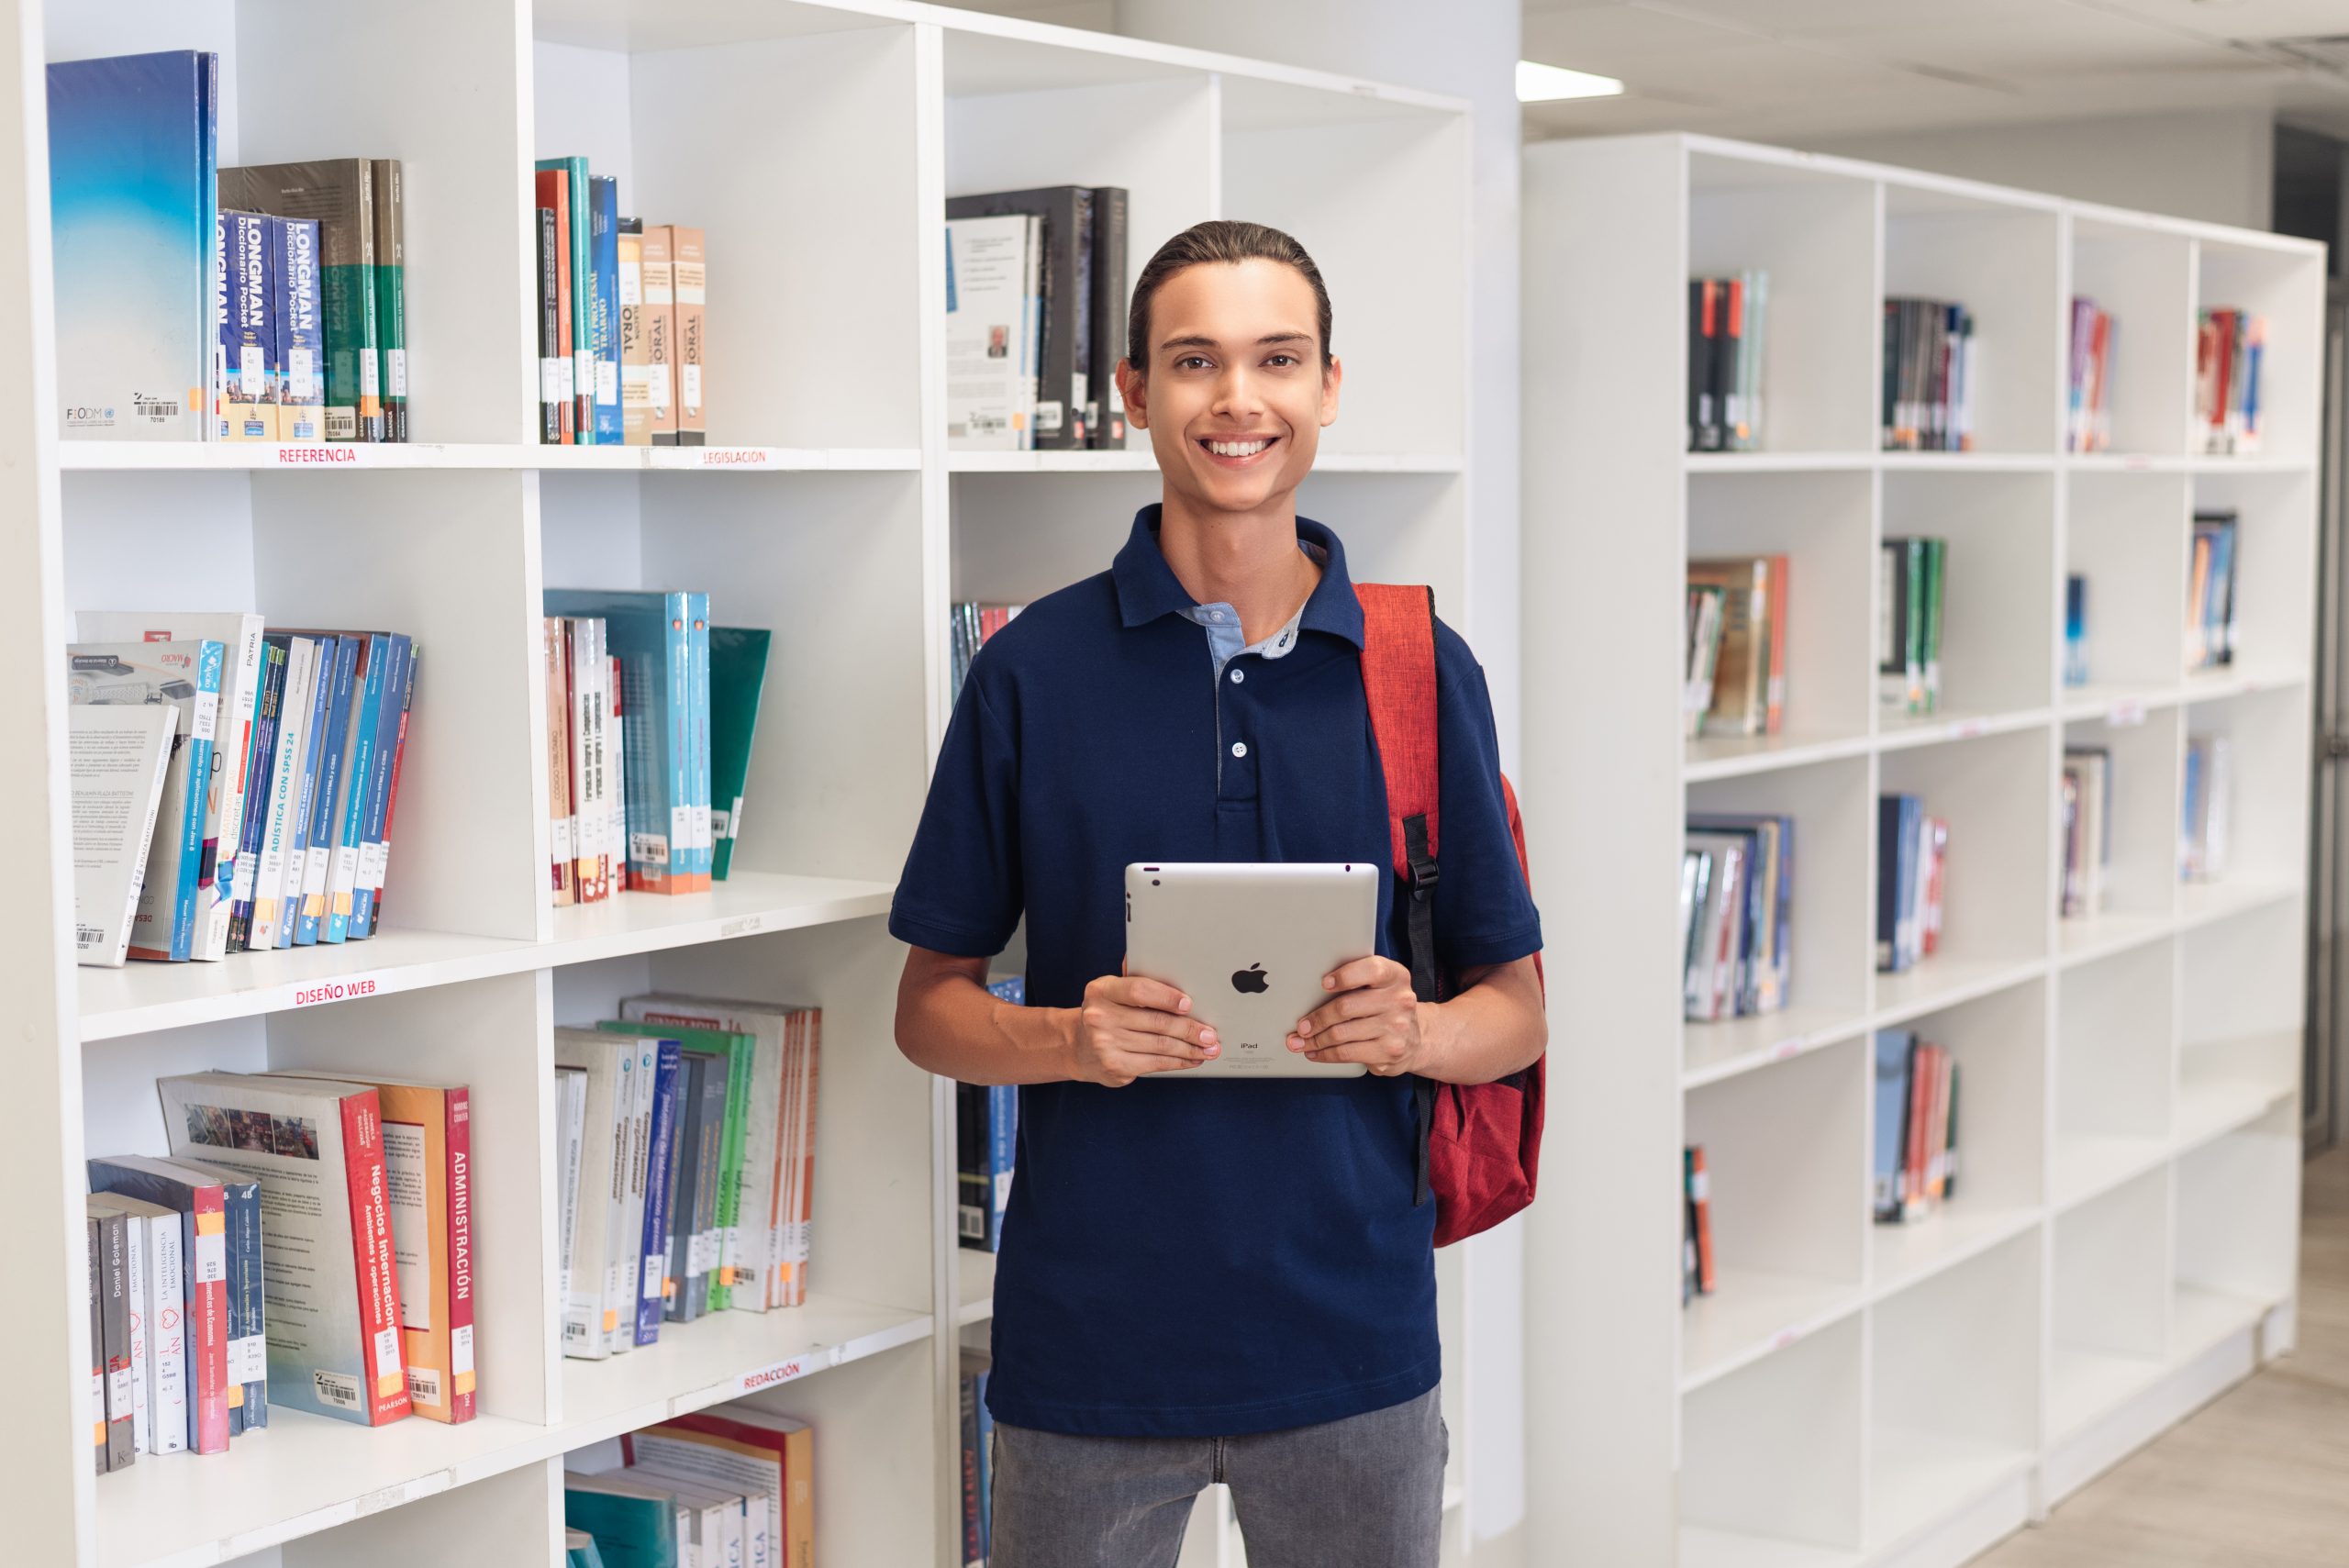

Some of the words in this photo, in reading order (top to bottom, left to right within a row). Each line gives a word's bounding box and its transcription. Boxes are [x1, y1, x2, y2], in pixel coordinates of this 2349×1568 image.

[238, 217, 248, 284] Diccionario
[247, 217, 264, 327] LONGMAN
[286, 222, 296, 288] Diccionario
[296, 223, 313, 330] LONGMAN
[240, 286, 249, 328] Pocket
[289, 291, 298, 332] Pocket
[623, 305, 634, 354] ORAL
[653, 316, 663, 365] ORAL
[279, 448, 356, 462] REFERENCIA
[161, 654, 184, 663] MACRO
[246, 633, 256, 667] PATRIA
[197, 740, 205, 768] esarrollo
[283, 747, 293, 774] SPSS
[287, 732, 294, 746] 24
[193, 778, 201, 818] aplicaciones
[278, 776, 289, 800] CON
[231, 796, 243, 840] discretas
[271, 803, 285, 852] ADÍSTICA
[296, 984, 344, 1005] DISEÑO
[347, 980, 376, 996] WEB
[661, 1094, 671, 1140] Sistemas
[612, 1122, 622, 1200] organizacional
[619, 1116, 629, 1205] Comportamiento
[631, 1118, 641, 1194] organizacional
[639, 1112, 651, 1200] Comportamiento
[659, 1140, 667, 1155] de
[241, 1191, 252, 1199] 4B
[371, 1164, 385, 1236] Negocios
[655, 1155, 666, 1216] información
[112, 1223, 121, 1266] Goleman
[454, 1151, 472, 1300] ADMINISTRACIÓN
[113, 1268, 122, 1298] Daniel
[365, 1204, 375, 1256] Ambientes
[370, 1266, 382, 1325] operaciones
[161, 1290, 167, 1301] LA
[744, 1362, 800, 1389] REDACCIÓN
[378, 1396, 408, 1412] PEARSON
